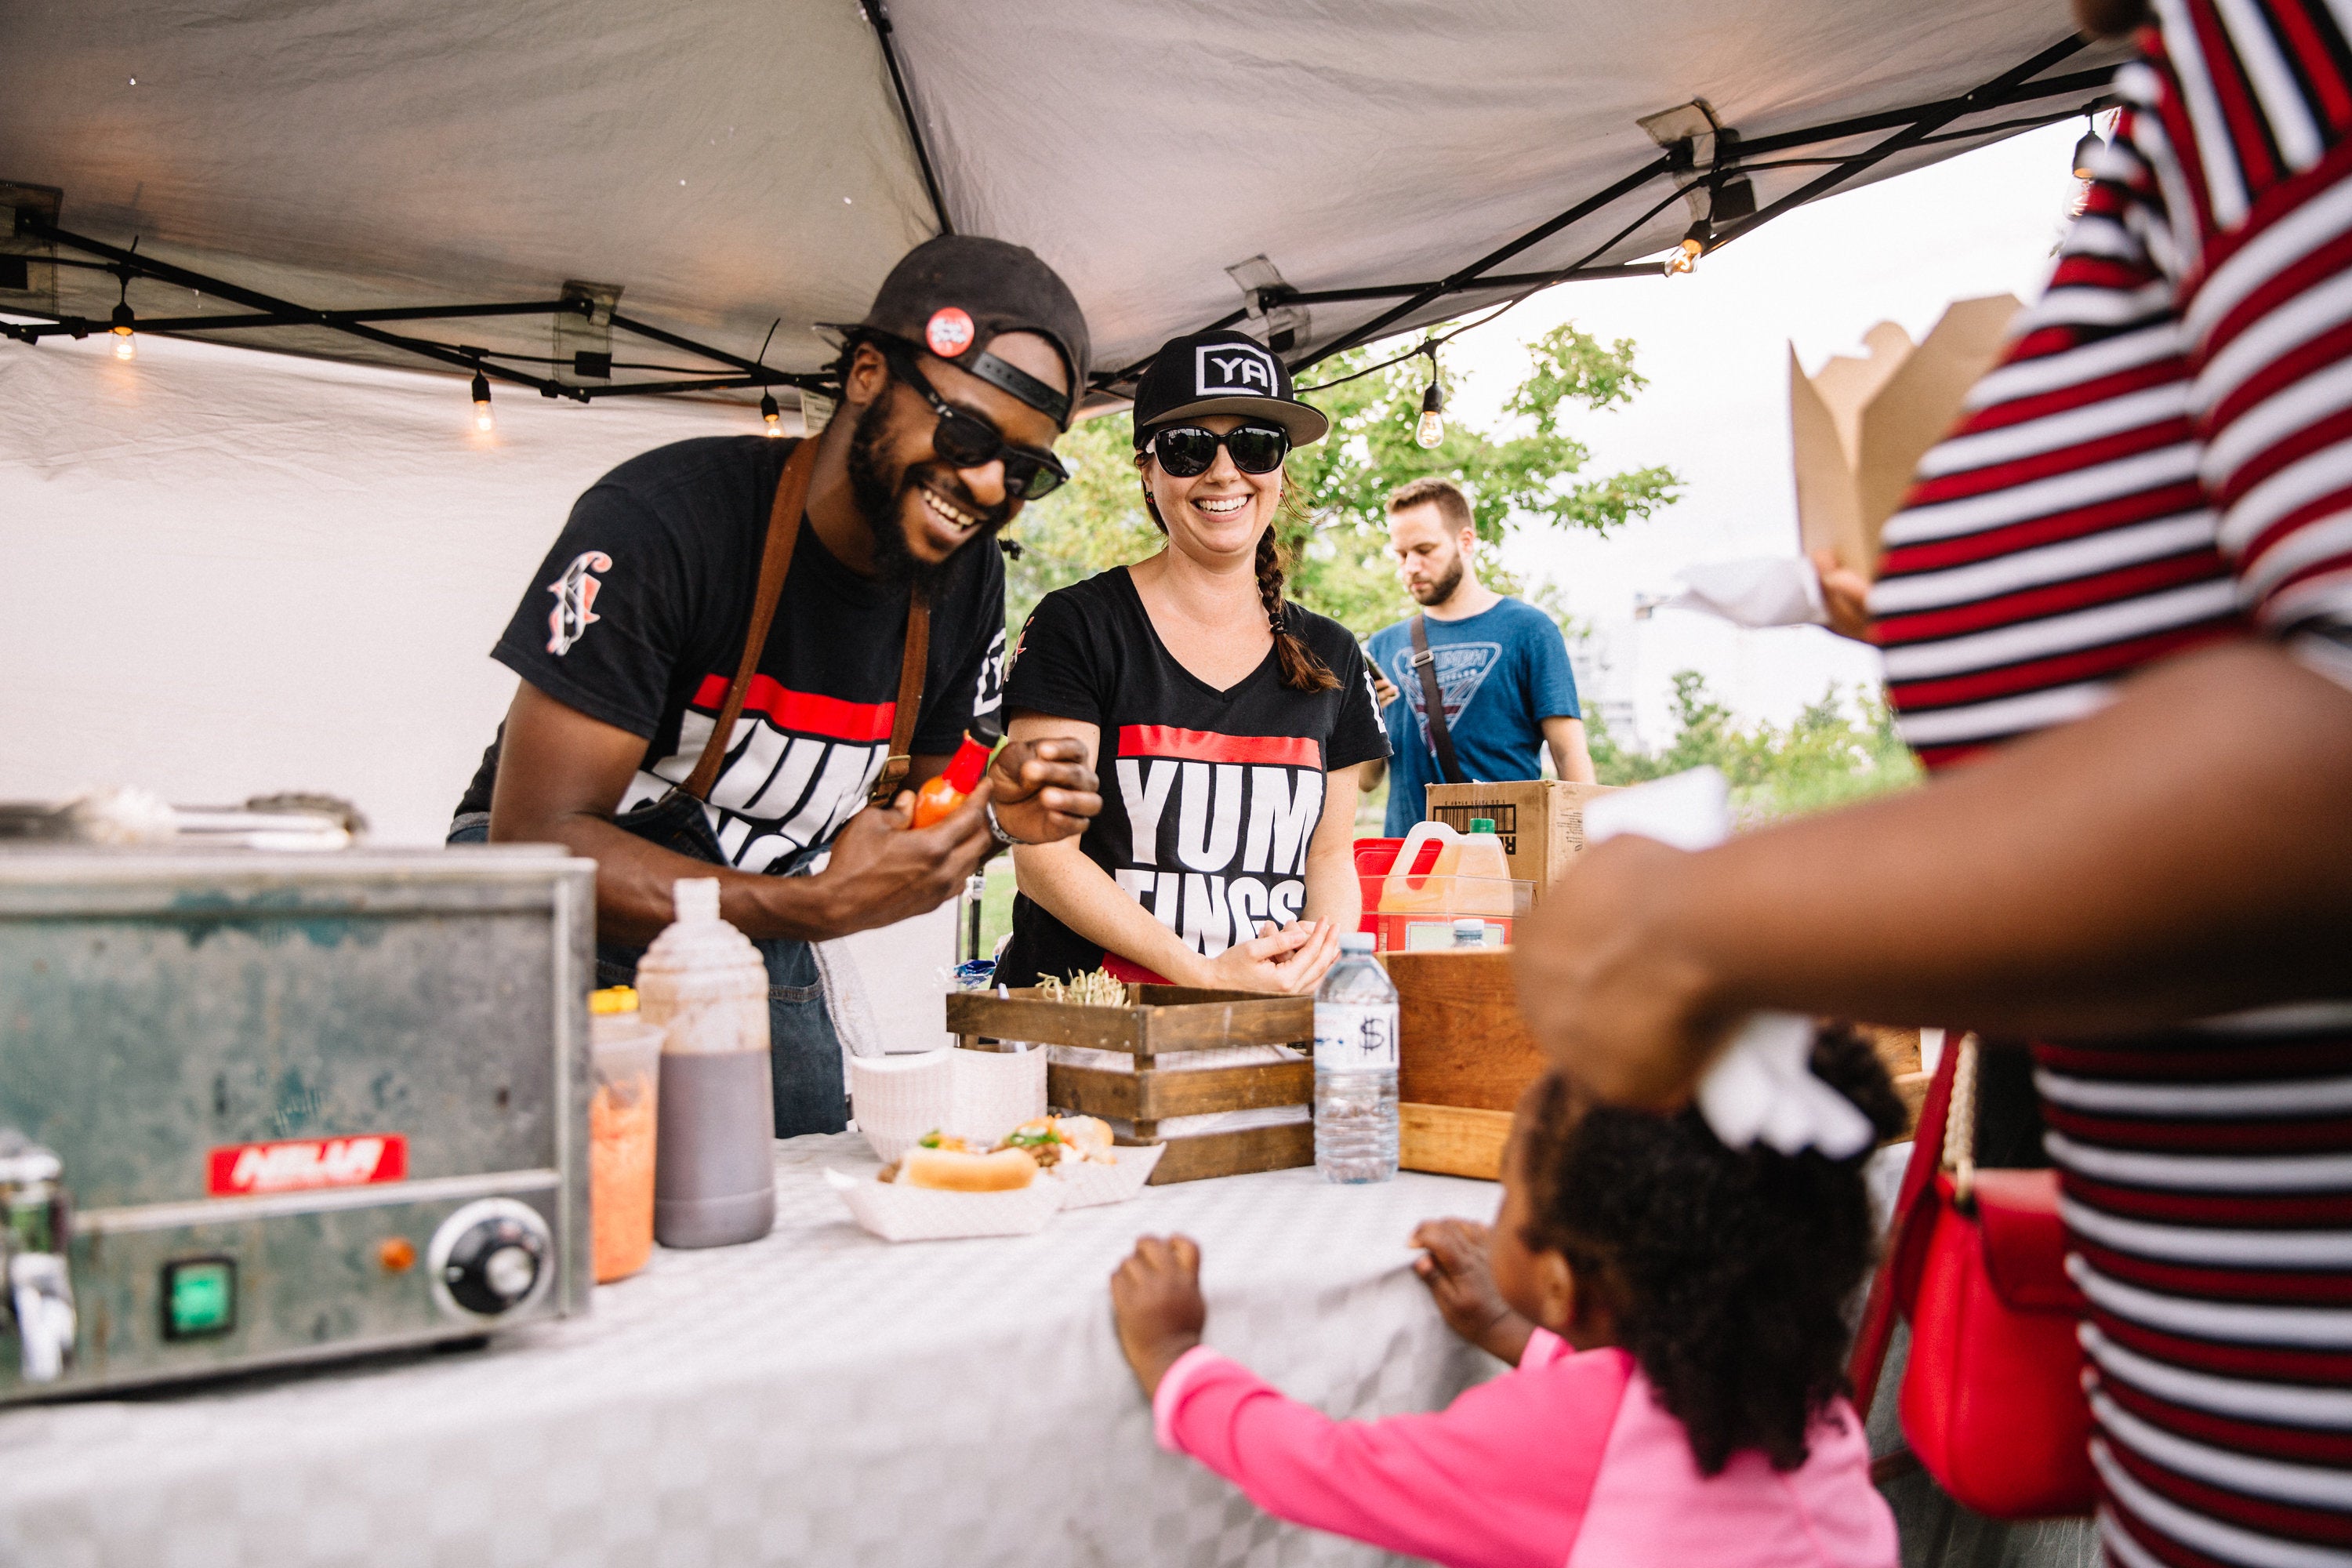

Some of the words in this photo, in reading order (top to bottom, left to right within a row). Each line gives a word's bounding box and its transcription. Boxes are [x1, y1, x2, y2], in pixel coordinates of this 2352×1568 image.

[1210, 358, 1268, 387] YA
[1115, 758, 1323, 876] YUM
[1359, 1014, 1395, 1062] $1
